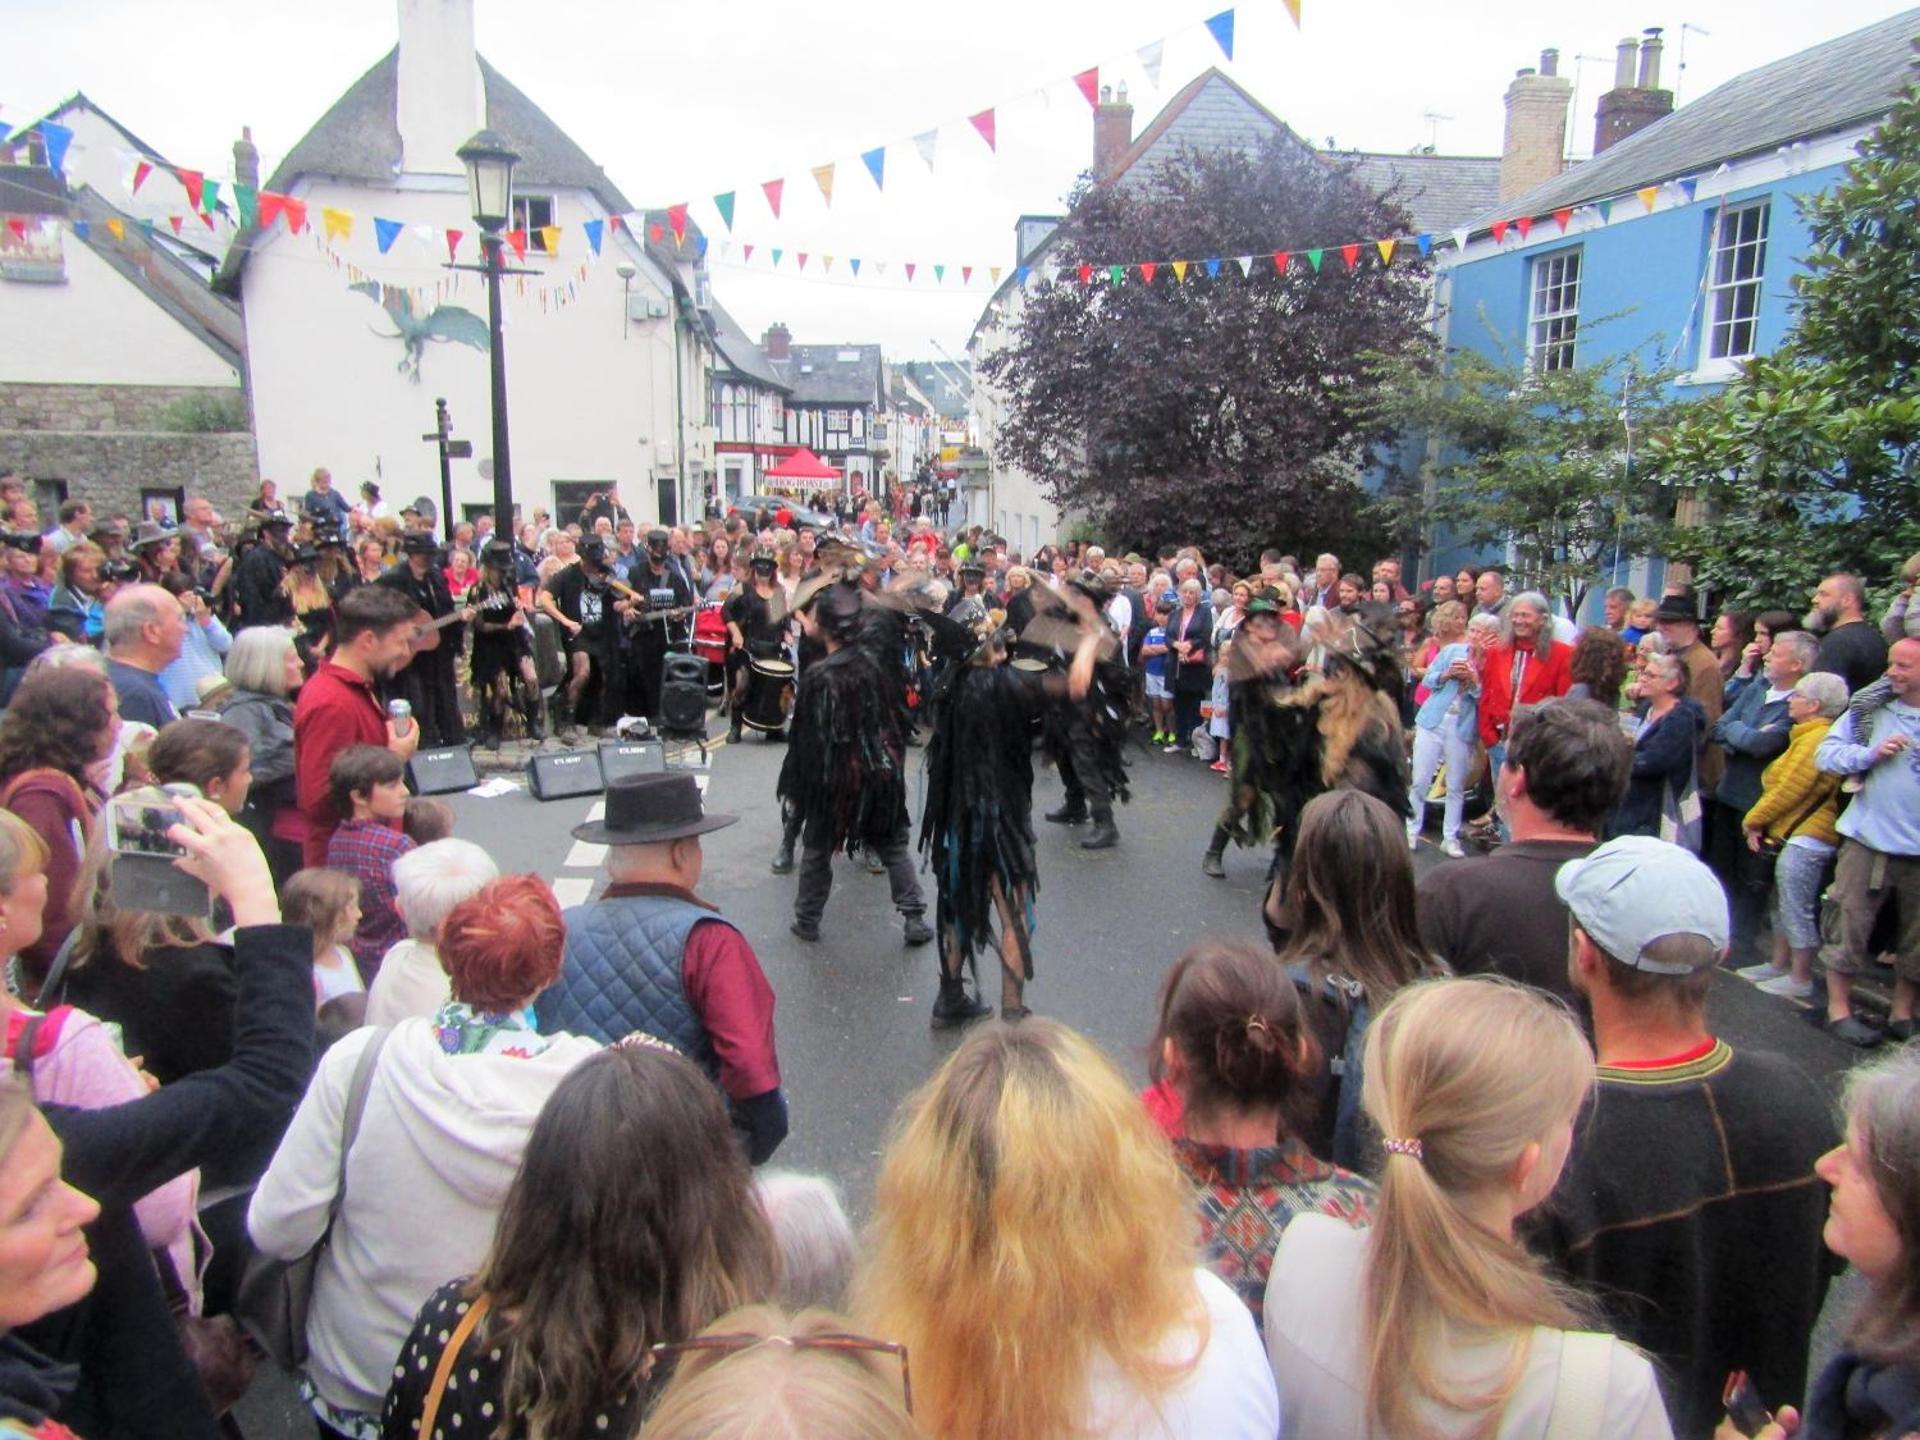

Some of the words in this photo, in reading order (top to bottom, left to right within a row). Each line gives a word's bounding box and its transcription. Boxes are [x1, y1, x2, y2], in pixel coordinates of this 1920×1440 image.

[776, 478, 796, 487] HOG
[797, 478, 823, 488] ROAST
[619, 747, 646, 755] CUBE
